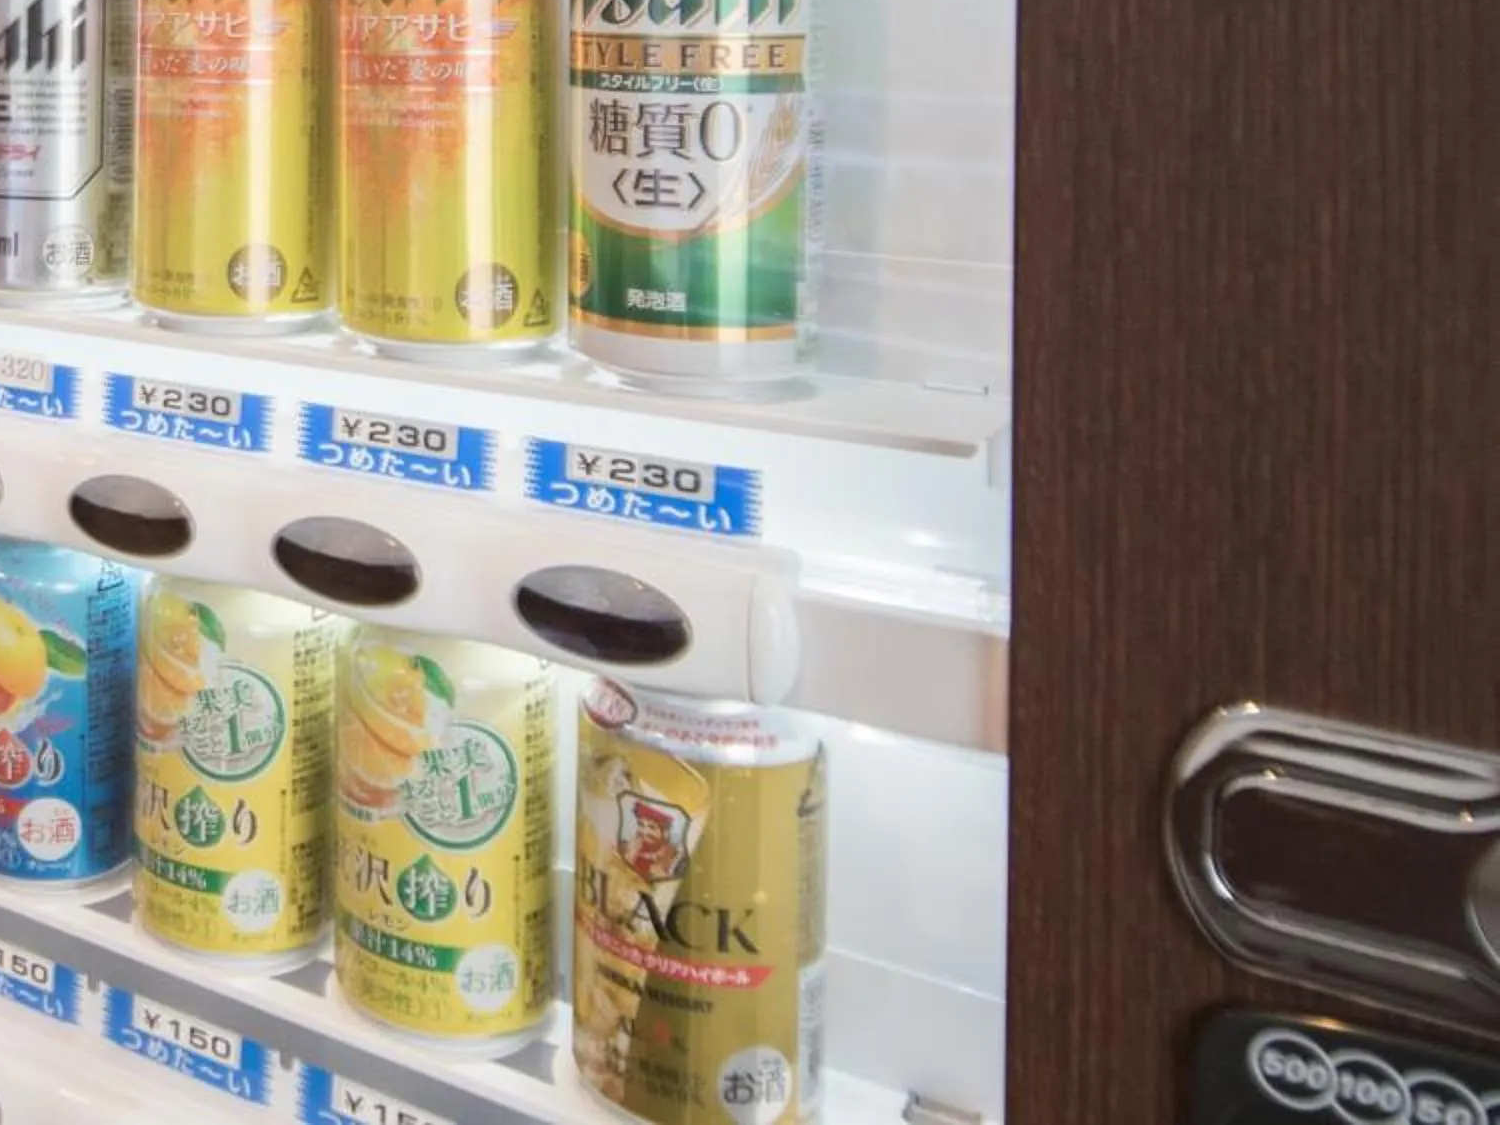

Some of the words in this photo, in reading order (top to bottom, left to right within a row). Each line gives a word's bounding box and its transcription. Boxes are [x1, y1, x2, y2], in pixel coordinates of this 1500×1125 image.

[574, 42, 662, 68] TYLE
[680, 42, 786, 69] FREE
[588, 98, 742, 163] 糖質0
[626, 288, 688, 313] 発泡酒
[138, 384, 233, 418] ¥230
[340, 415, 449, 453] ¥230
[576, 450, 703, 495] ¥230
[21, 807, 78, 846] お酒
[350, 843, 493, 920] 沢搾り
[226, 885, 280, 917] お酒
[460, 961, 516, 995] お酒
[141, 1006, 233, 1060] ¥150
[1262, 1047, 1328, 1091] 500
[1339, 1071, 1403, 1113] 100
